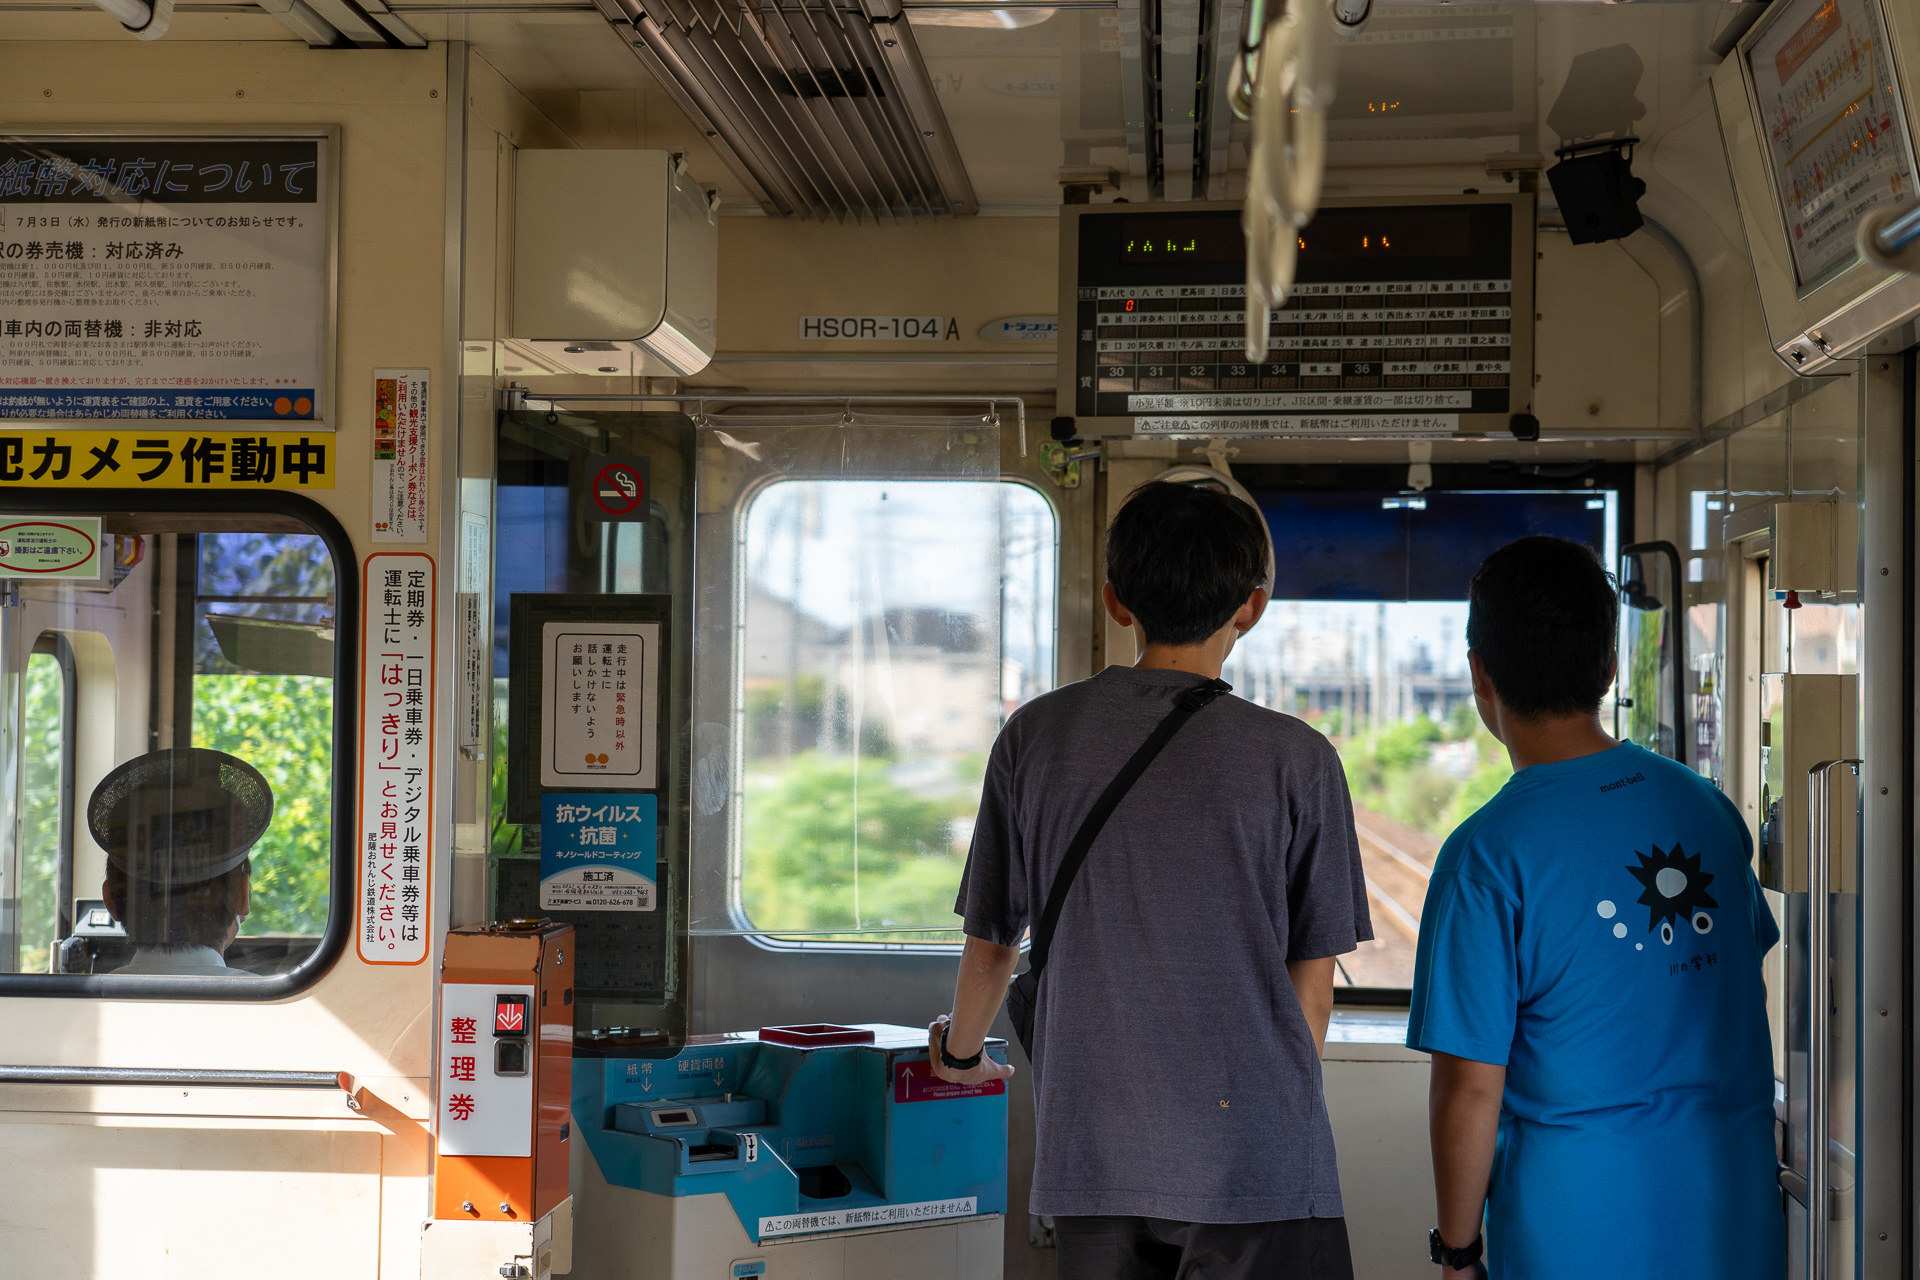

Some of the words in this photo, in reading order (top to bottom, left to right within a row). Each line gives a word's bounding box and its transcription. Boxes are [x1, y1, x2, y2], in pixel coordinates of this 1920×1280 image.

[0, 319, 202, 338] 車内の両替機：非対応
[1021, 331, 1048, 340] 2003
[1109, 367, 1124, 377] 30
[1149, 366, 1164, 376] 31
[1190, 366, 1205, 376] 32
[1231, 365, 1246, 375] 33
[1271, 365, 1287, 375] 34
[1354, 364, 1370, 374] 36
[0, 396, 273, 407] は釣銭が無いように運賃表をご確認の上、運賃をご用意ください。
[601, 643, 613, 690] 運転士に
[572, 643, 583, 714] お願いします
[586, 643, 598, 739] 話しかけないよう
[615, 643, 627, 752] 走行中は緊急時以外
[378, 569, 403, 952] 運転士に「はっきり」とお見せください。
[402, 570, 425, 942] 定期券・一日乗車券・デジタル乗車券等は
[556, 805, 642, 823] 抗ウイルス
[580, 827, 617, 846] 抗菌
[556, 850, 642, 860] キノシールドコーティング
[583, 871, 614, 882] 施工済
[366, 832, 377, 943] 肥薩おれんじ鉄道株式会社
[449, 1017, 477, 1121] 整理券
[627, 1062, 652, 1076] 紙幣
[678, 1057, 725, 1072] 硬貨両替
[775, 1202, 963, 1230] この両替機では、新紙幣はご利用いただけません
